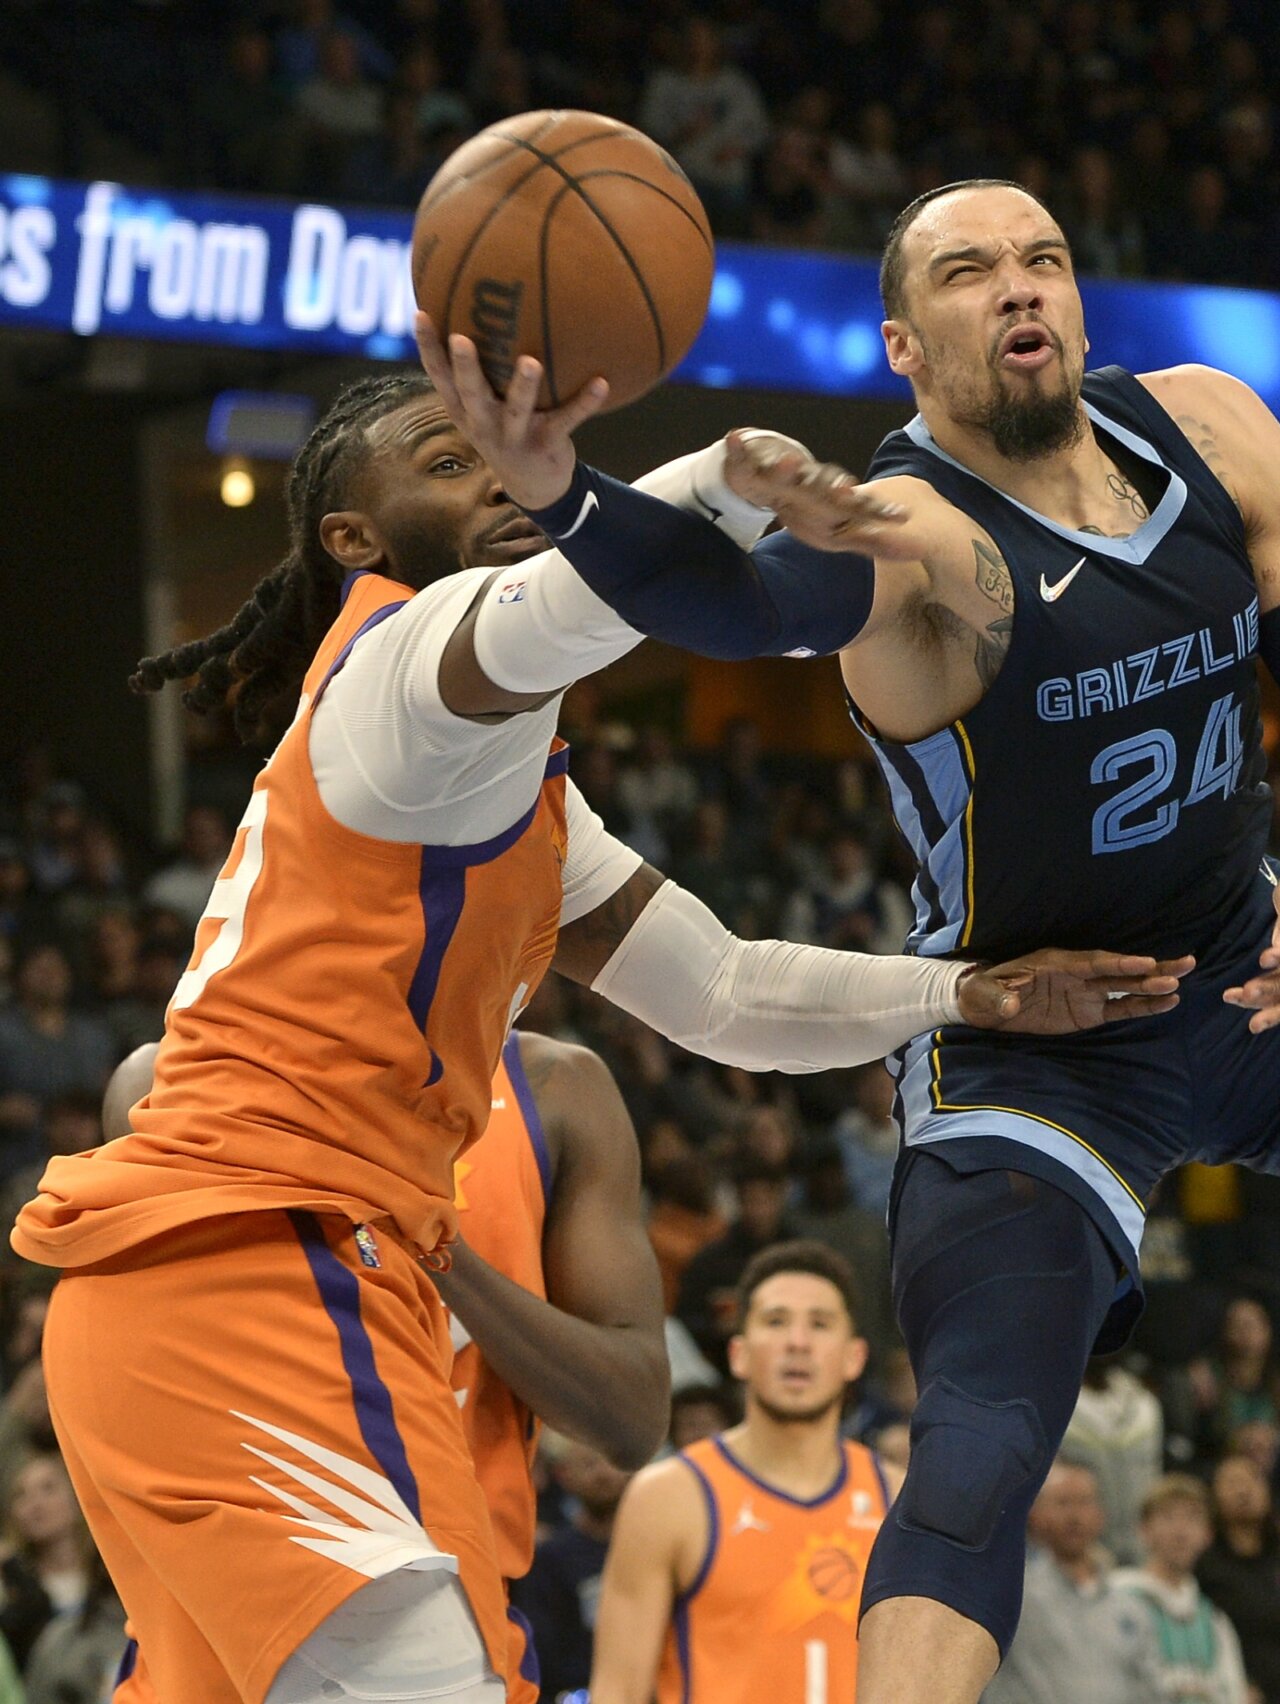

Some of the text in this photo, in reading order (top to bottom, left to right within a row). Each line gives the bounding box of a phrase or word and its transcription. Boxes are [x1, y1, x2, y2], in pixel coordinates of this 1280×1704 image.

[0, 204, 56, 307] s
[72, 180, 269, 336] from
[1090, 692, 1244, 856] 24
